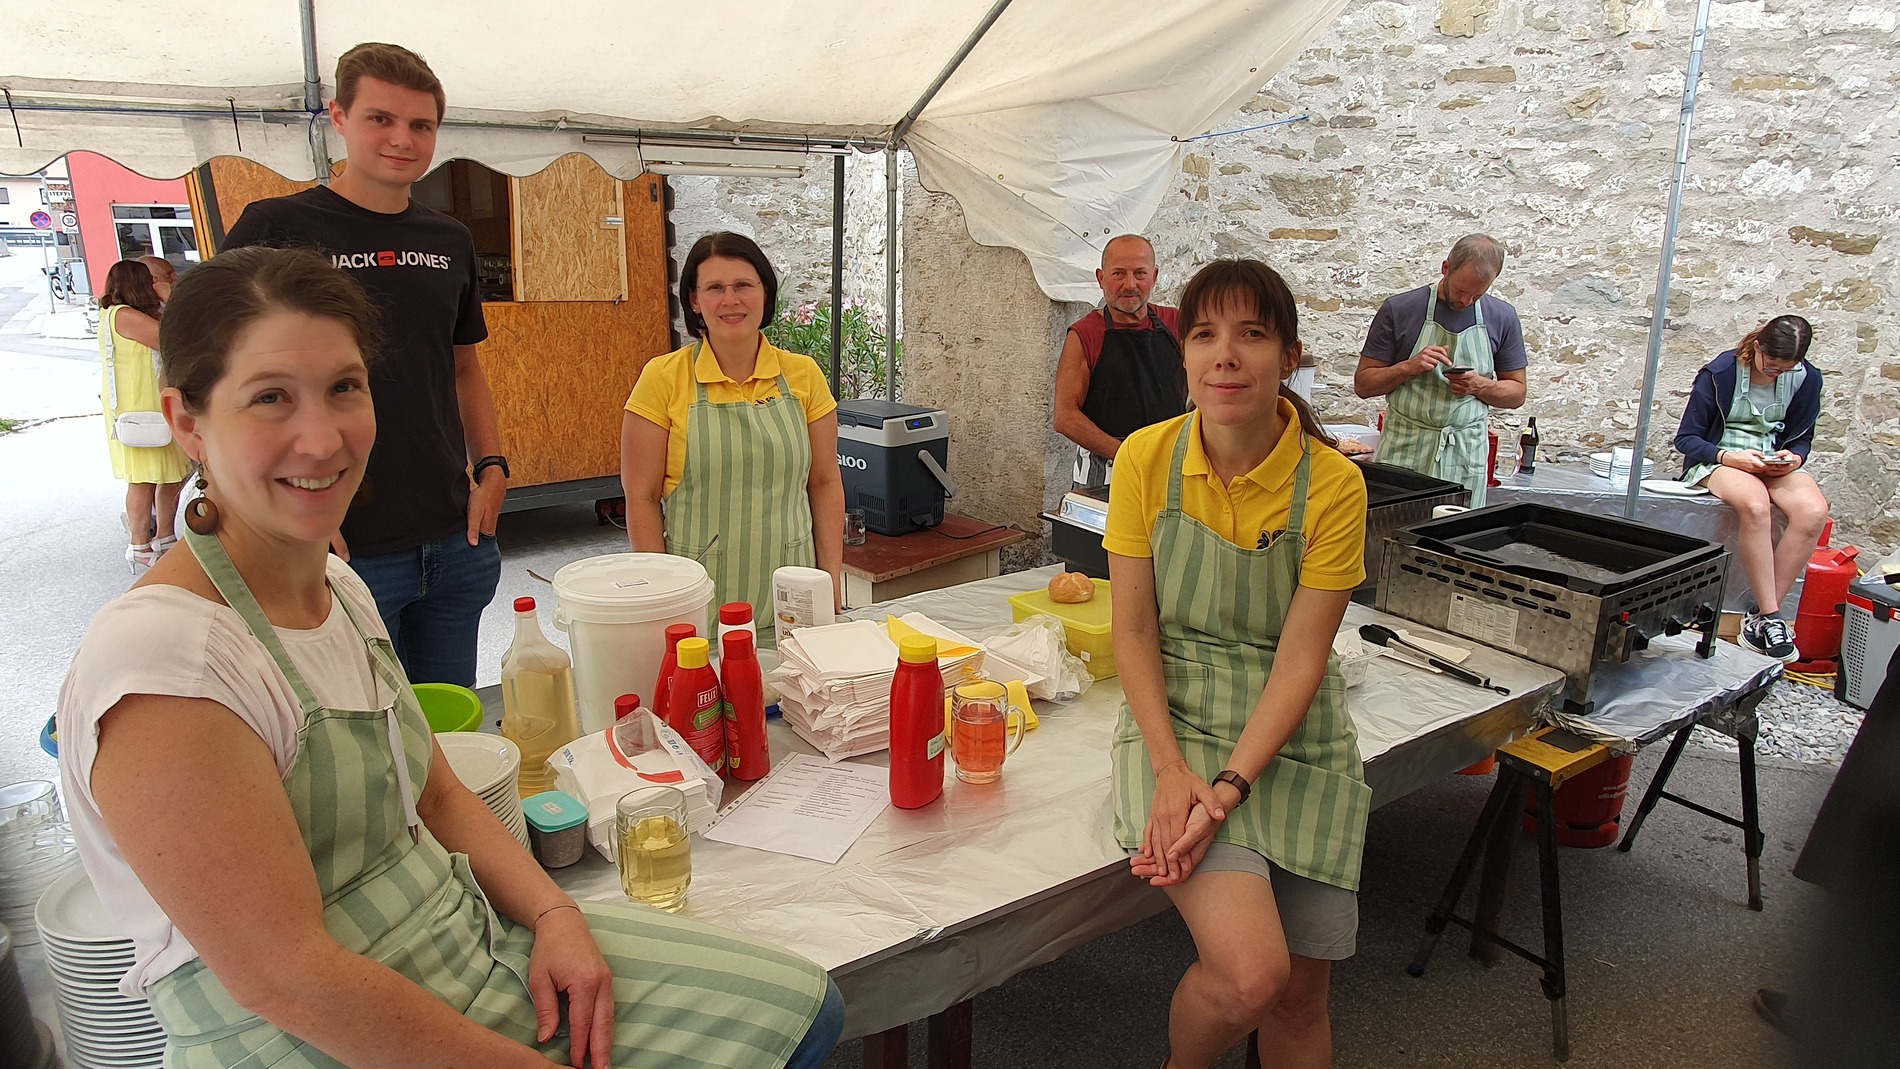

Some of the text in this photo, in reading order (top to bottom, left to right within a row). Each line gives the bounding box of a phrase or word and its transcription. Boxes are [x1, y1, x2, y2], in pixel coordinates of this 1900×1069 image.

[331, 252, 378, 269] JACK
[836, 453, 867, 470] GLOO
[700, 689, 717, 705] FELIX
